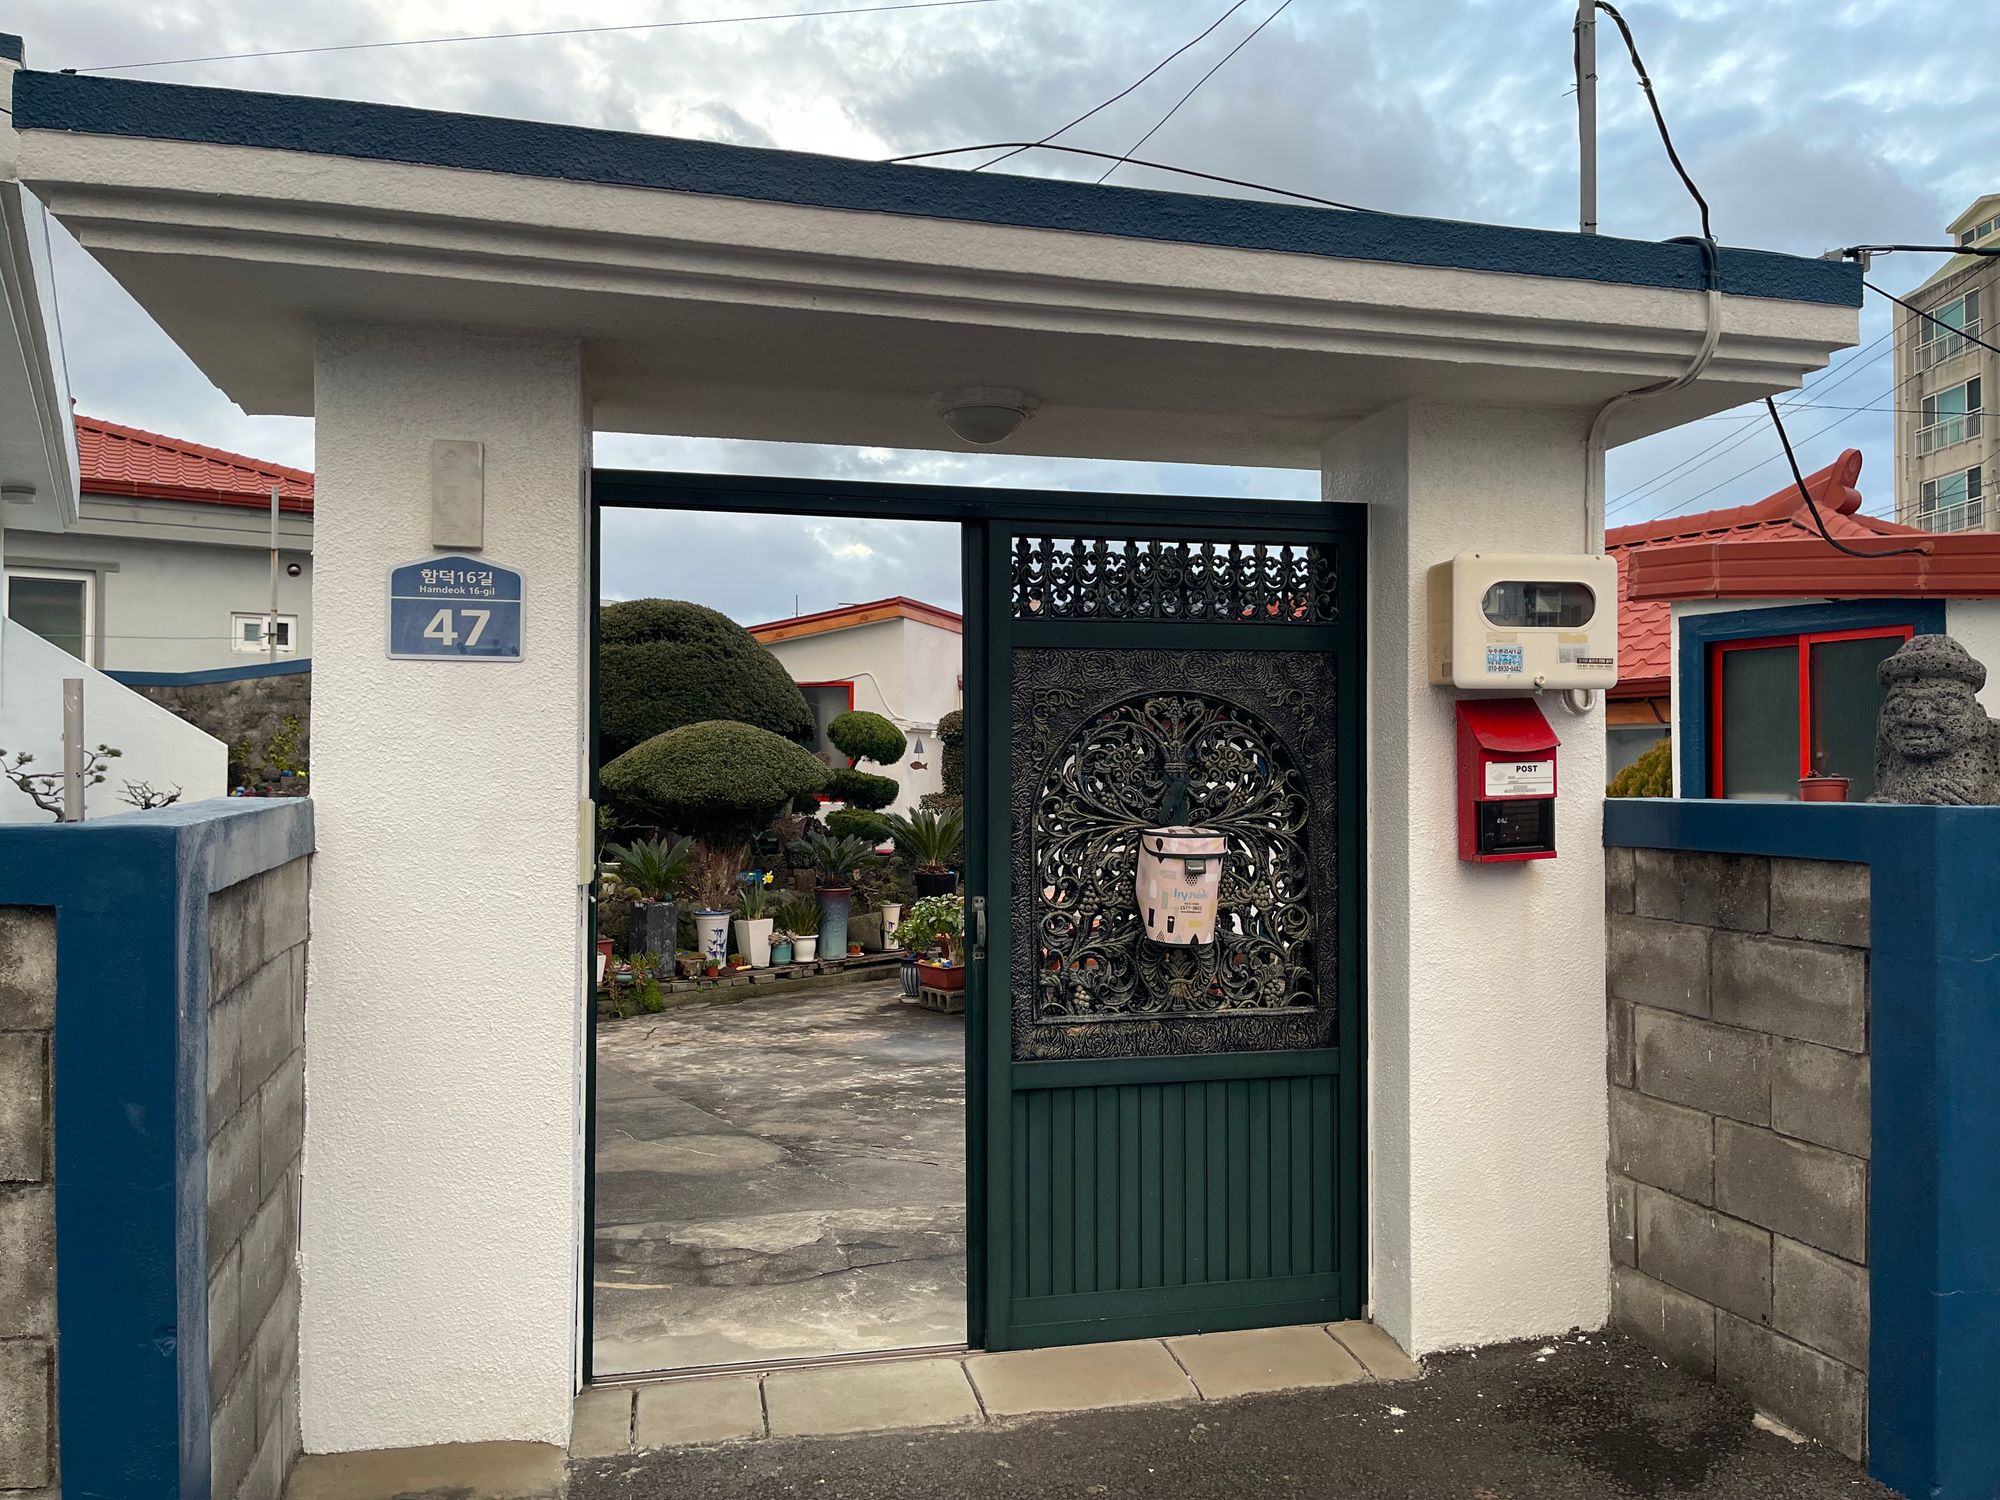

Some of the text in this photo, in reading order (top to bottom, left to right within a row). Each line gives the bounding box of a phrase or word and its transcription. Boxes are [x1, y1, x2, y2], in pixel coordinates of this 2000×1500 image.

[420, 568, 493, 586] 함덕16길
[419, 585, 495, 596] Hamdeok 16-gil
[423, 608, 491, 646] 47
